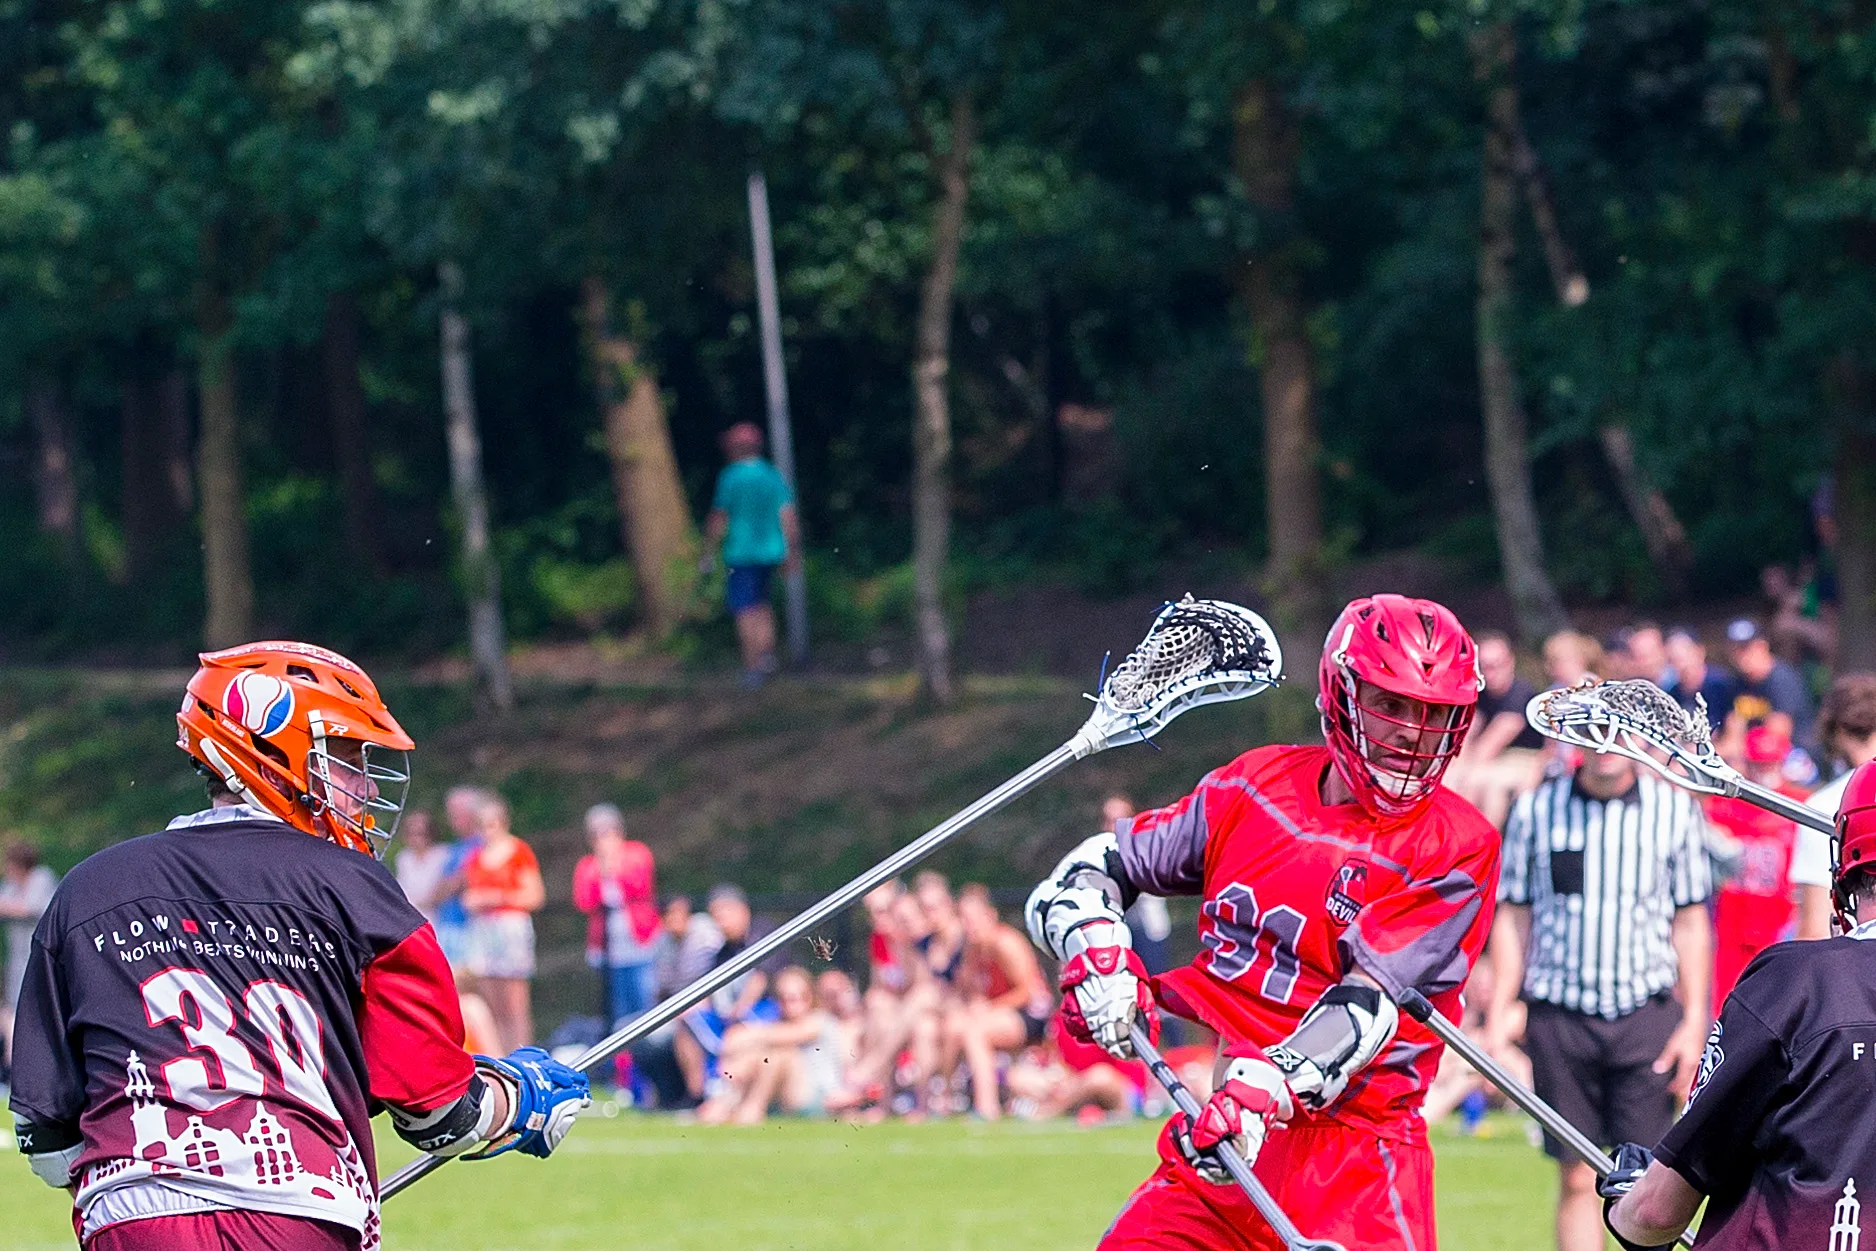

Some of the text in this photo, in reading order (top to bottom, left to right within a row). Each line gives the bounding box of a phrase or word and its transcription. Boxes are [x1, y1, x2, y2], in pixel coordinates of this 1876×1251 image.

[1325, 896, 1358, 924] DEVIL
[94, 914, 169, 953] FLOW
[1202, 881, 1308, 1005] 91
[139, 965, 346, 1116] 30
[418, 1128, 457, 1150] STX
